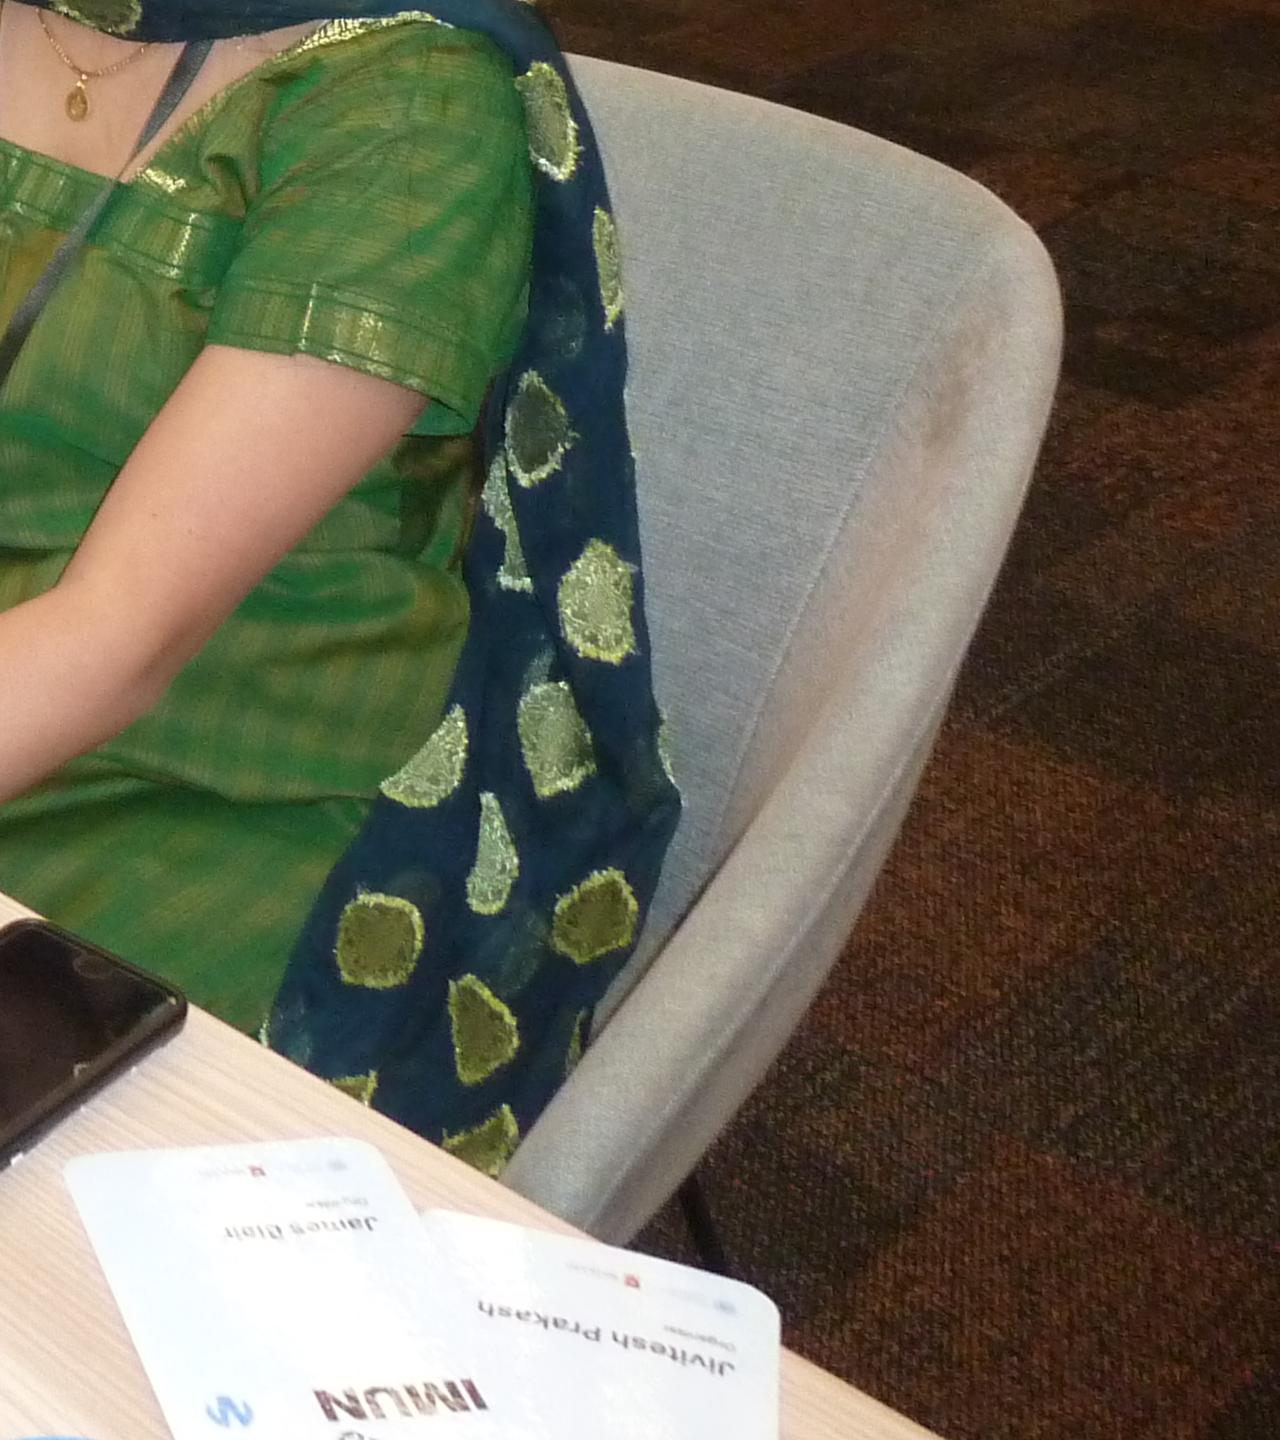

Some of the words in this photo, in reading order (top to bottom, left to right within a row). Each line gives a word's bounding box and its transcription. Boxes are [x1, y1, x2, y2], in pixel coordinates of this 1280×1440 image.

[292, 1213, 380, 1238] James
[476, 1298, 605, 1344] Prakash
[611, 1329, 737, 1377] Jivitesh
[312, 1378, 491, 1422] IMUN
